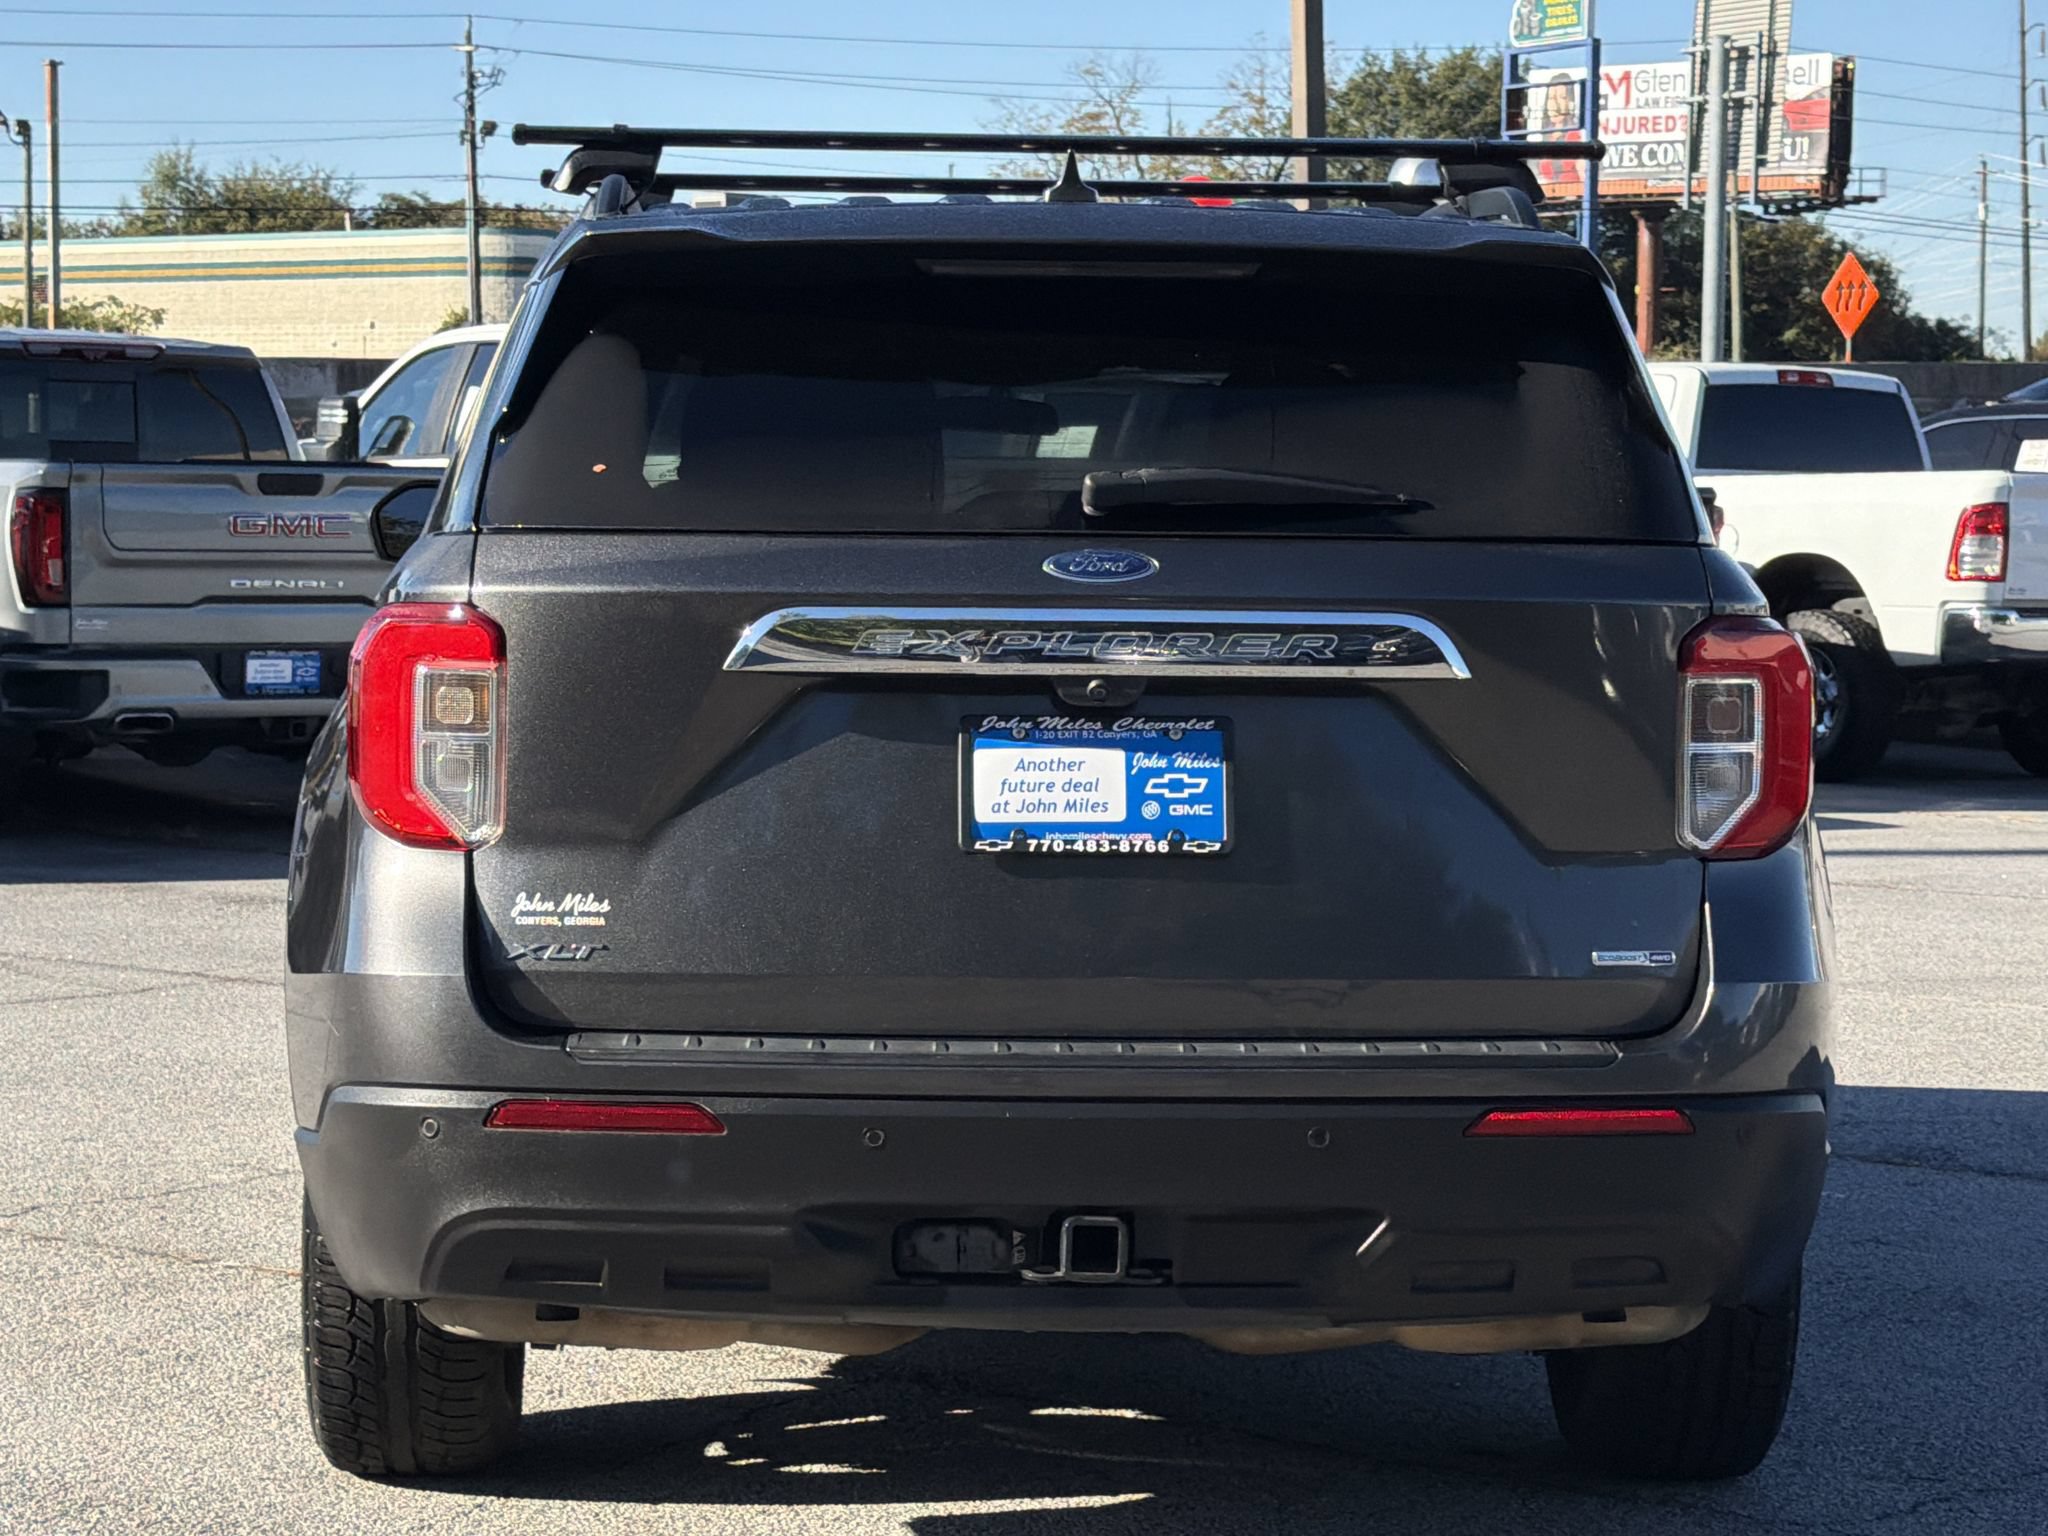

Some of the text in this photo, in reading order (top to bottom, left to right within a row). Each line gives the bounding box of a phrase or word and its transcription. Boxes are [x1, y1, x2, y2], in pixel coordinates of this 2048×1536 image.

[1600, 114, 1688, 135] NJURED?
[1602, 144, 1638, 168] WE
[228, 512, 354, 538] GMC
[1068, 551, 1135, 573] Ford
[230, 579, 344, 589] DENALI
[850, 628, 1340, 659] EXPLORER
[978, 715, 1215, 732] John Miles Chevrolet
[1057, 731, 1080, 739] EXIT
[1014, 757, 1086, 772] Another
[1131, 751, 1222, 775] John Miles
[1000, 777, 1100, 797] future deal
[991, 798, 1109, 814] at John Miles
[1168, 804, 1213, 816] GMC
[1027, 839, 1170, 853] 770-483-8766
[510, 891, 612, 918] John Miles
[563, 916, 606, 926] GEORGIA
[506, 943, 610, 961] XLT
